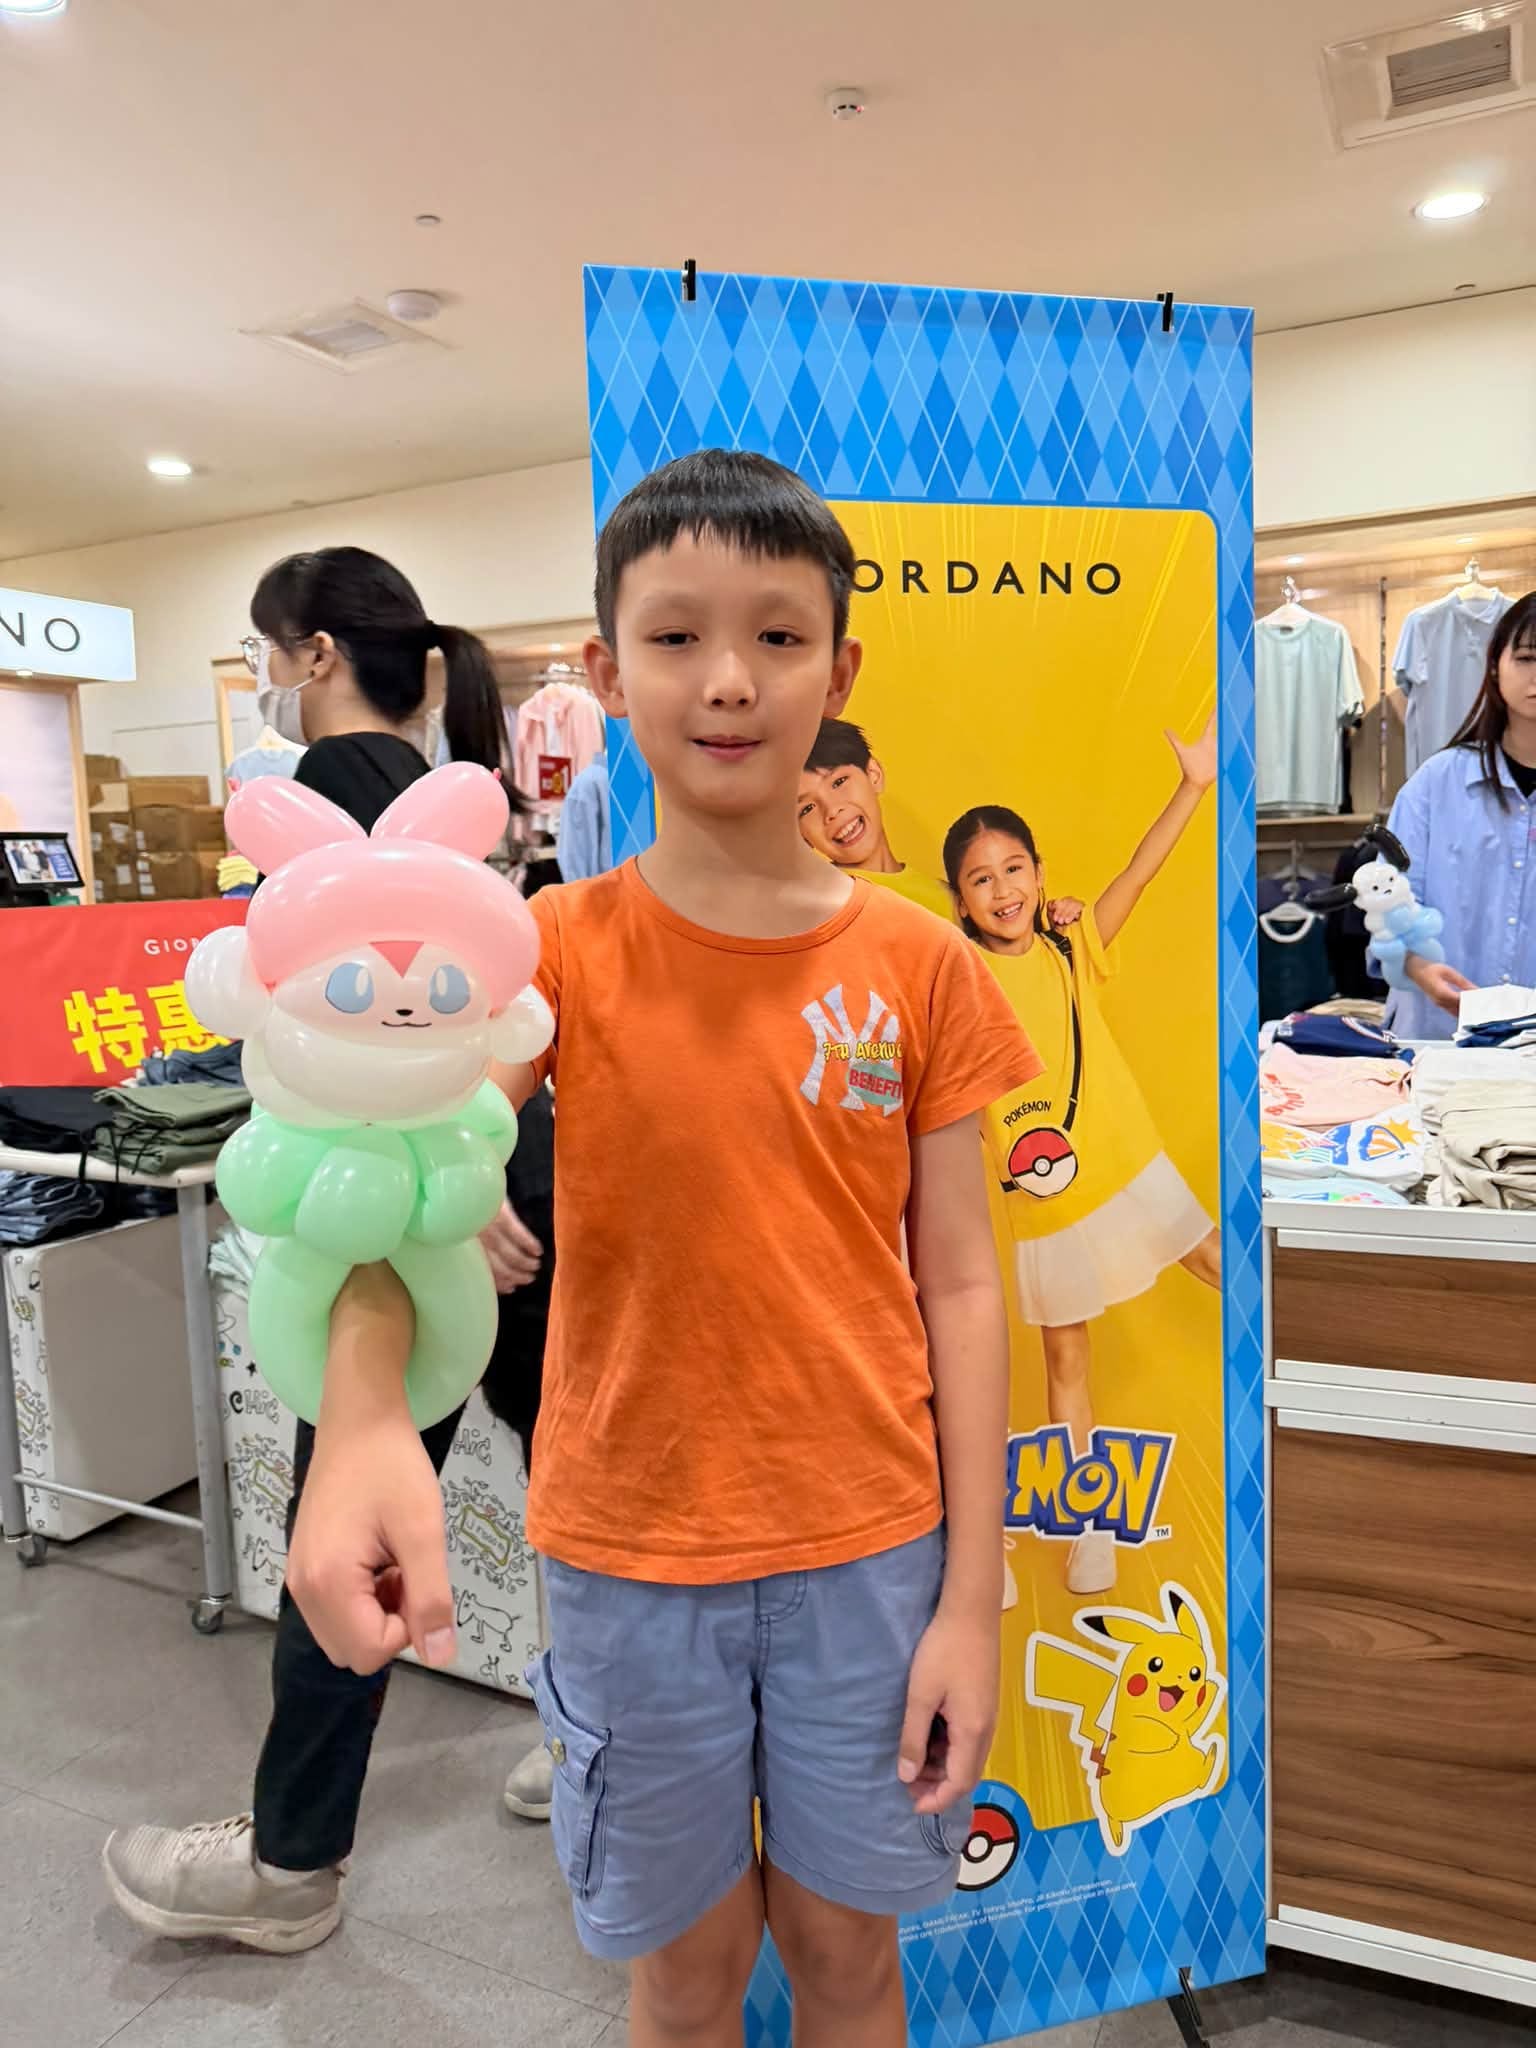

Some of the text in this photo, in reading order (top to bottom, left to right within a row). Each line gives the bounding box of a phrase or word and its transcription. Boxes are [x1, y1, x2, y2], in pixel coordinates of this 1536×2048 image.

[854, 559, 1121, 595] ORDANO
[0, 612, 80, 652] NO
[1003, 1100, 1051, 1127] POKÉMON
[1003, 1426, 1172, 1544] MON
